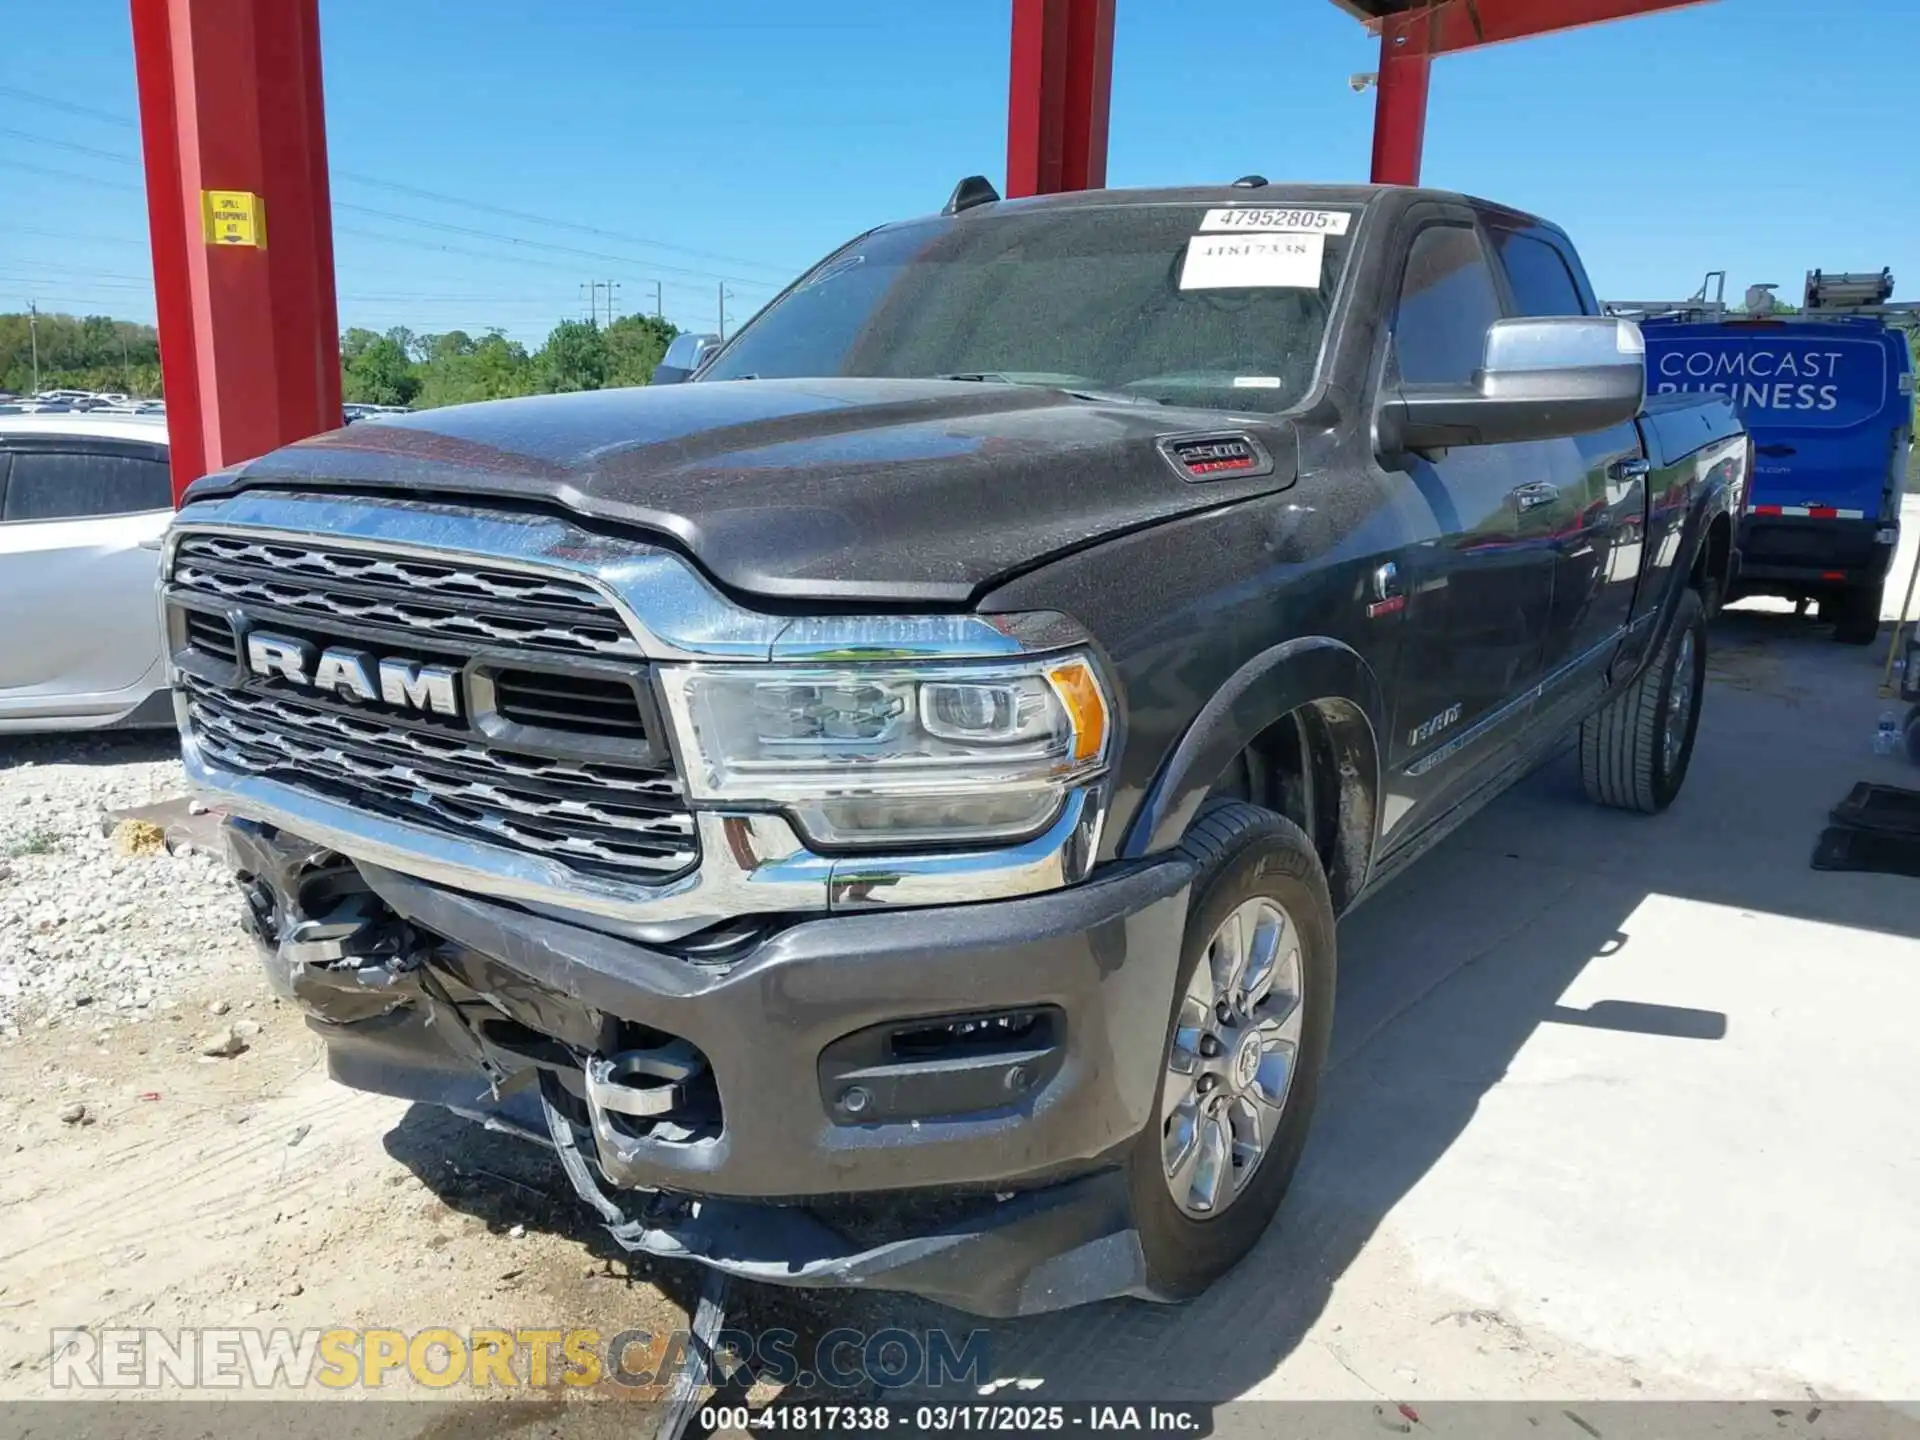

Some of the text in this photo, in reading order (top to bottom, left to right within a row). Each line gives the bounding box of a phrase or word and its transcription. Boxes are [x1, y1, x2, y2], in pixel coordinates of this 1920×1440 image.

[1660, 352, 1842, 378] COMCAST
[1180, 443, 1244, 462] 2500
[248, 630, 458, 715] RAM
